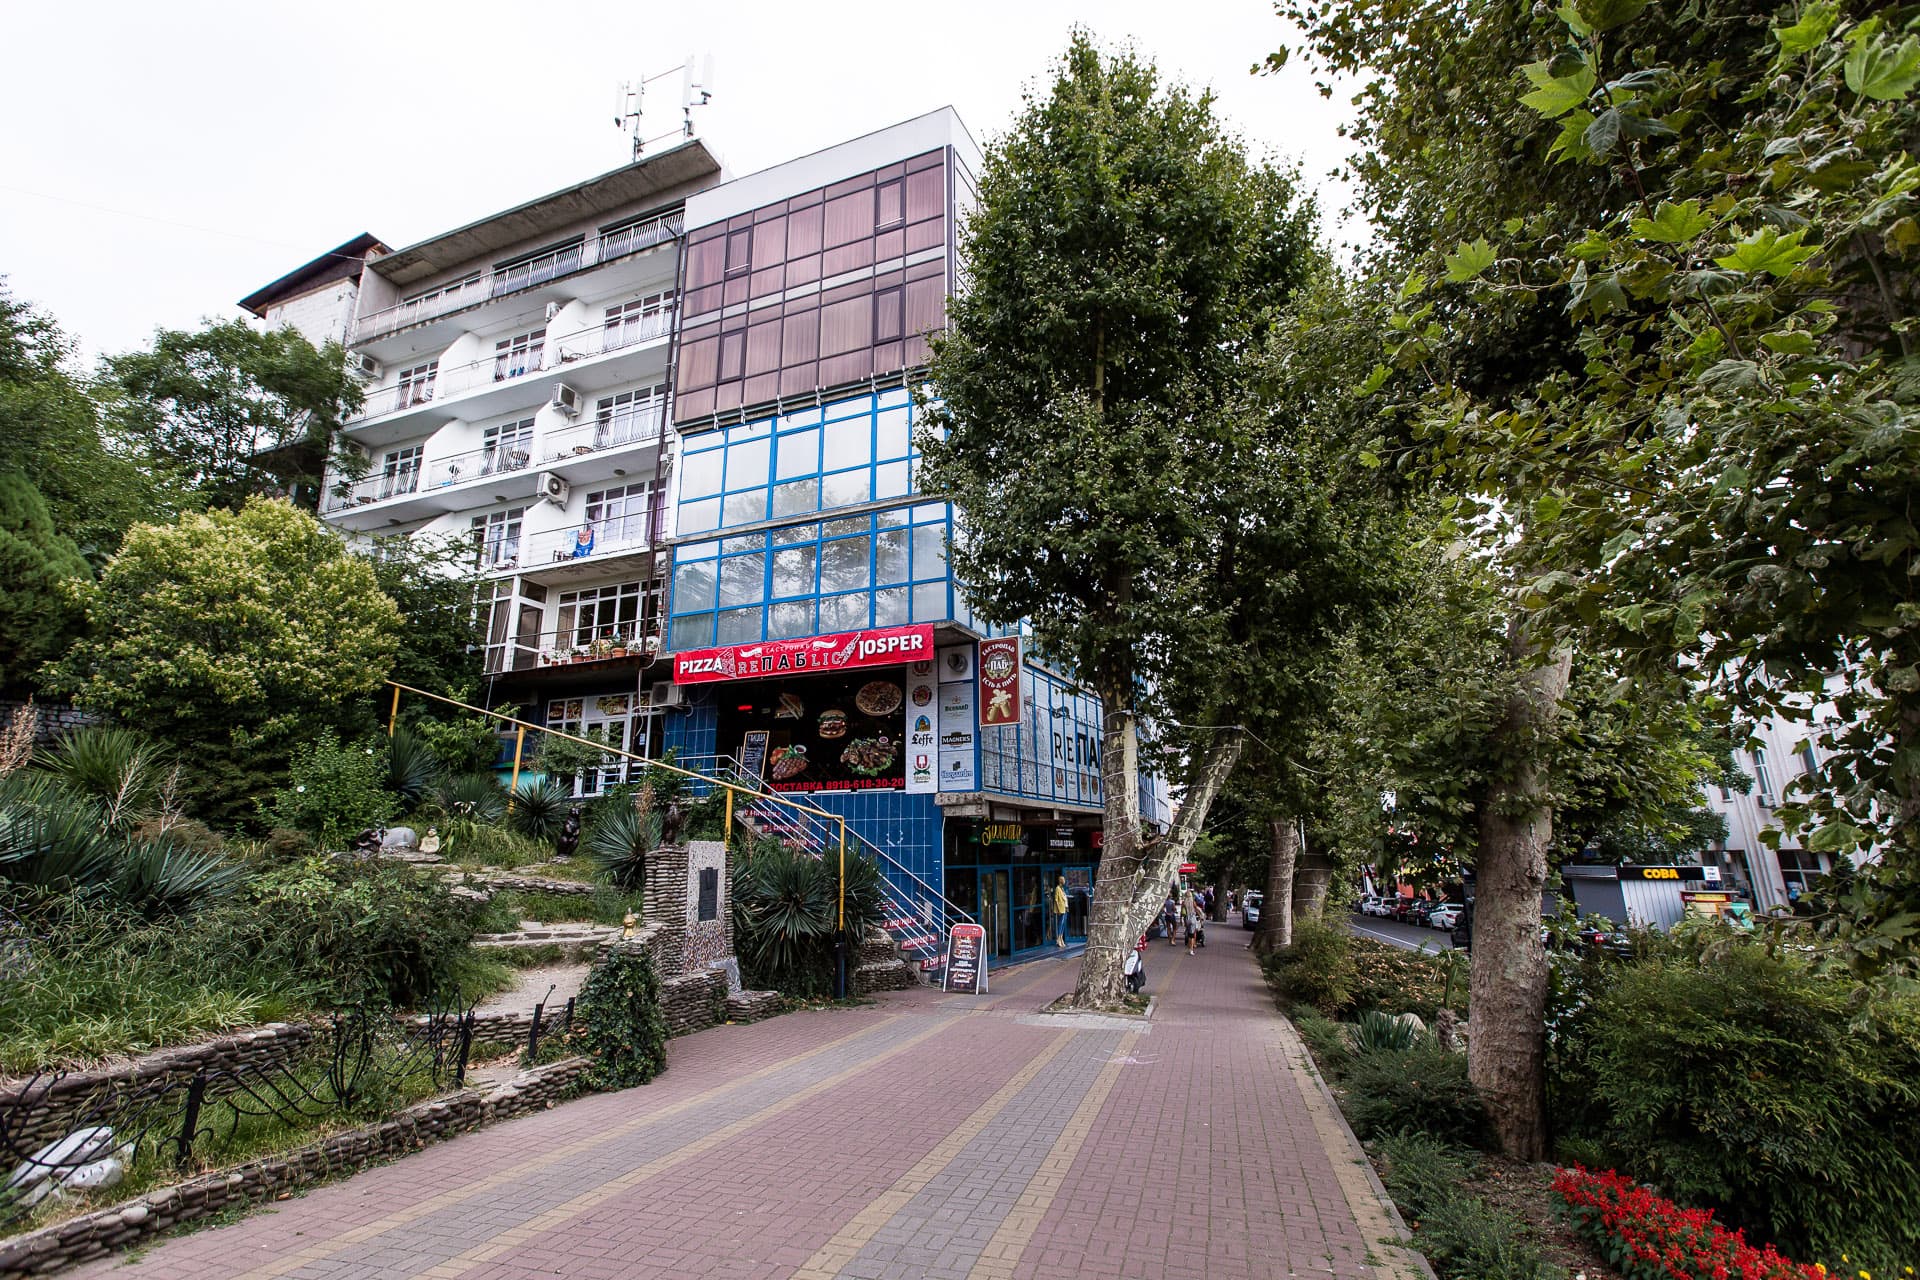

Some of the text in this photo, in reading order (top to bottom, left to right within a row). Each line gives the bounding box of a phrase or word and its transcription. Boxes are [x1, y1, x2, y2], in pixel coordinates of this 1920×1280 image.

[858, 634, 923, 660] JOSPER
[680, 657, 723, 674] PIZZA
[911, 733, 934, 747] Leffe
[826, 777, 905, 790] 8918-618-30-20
